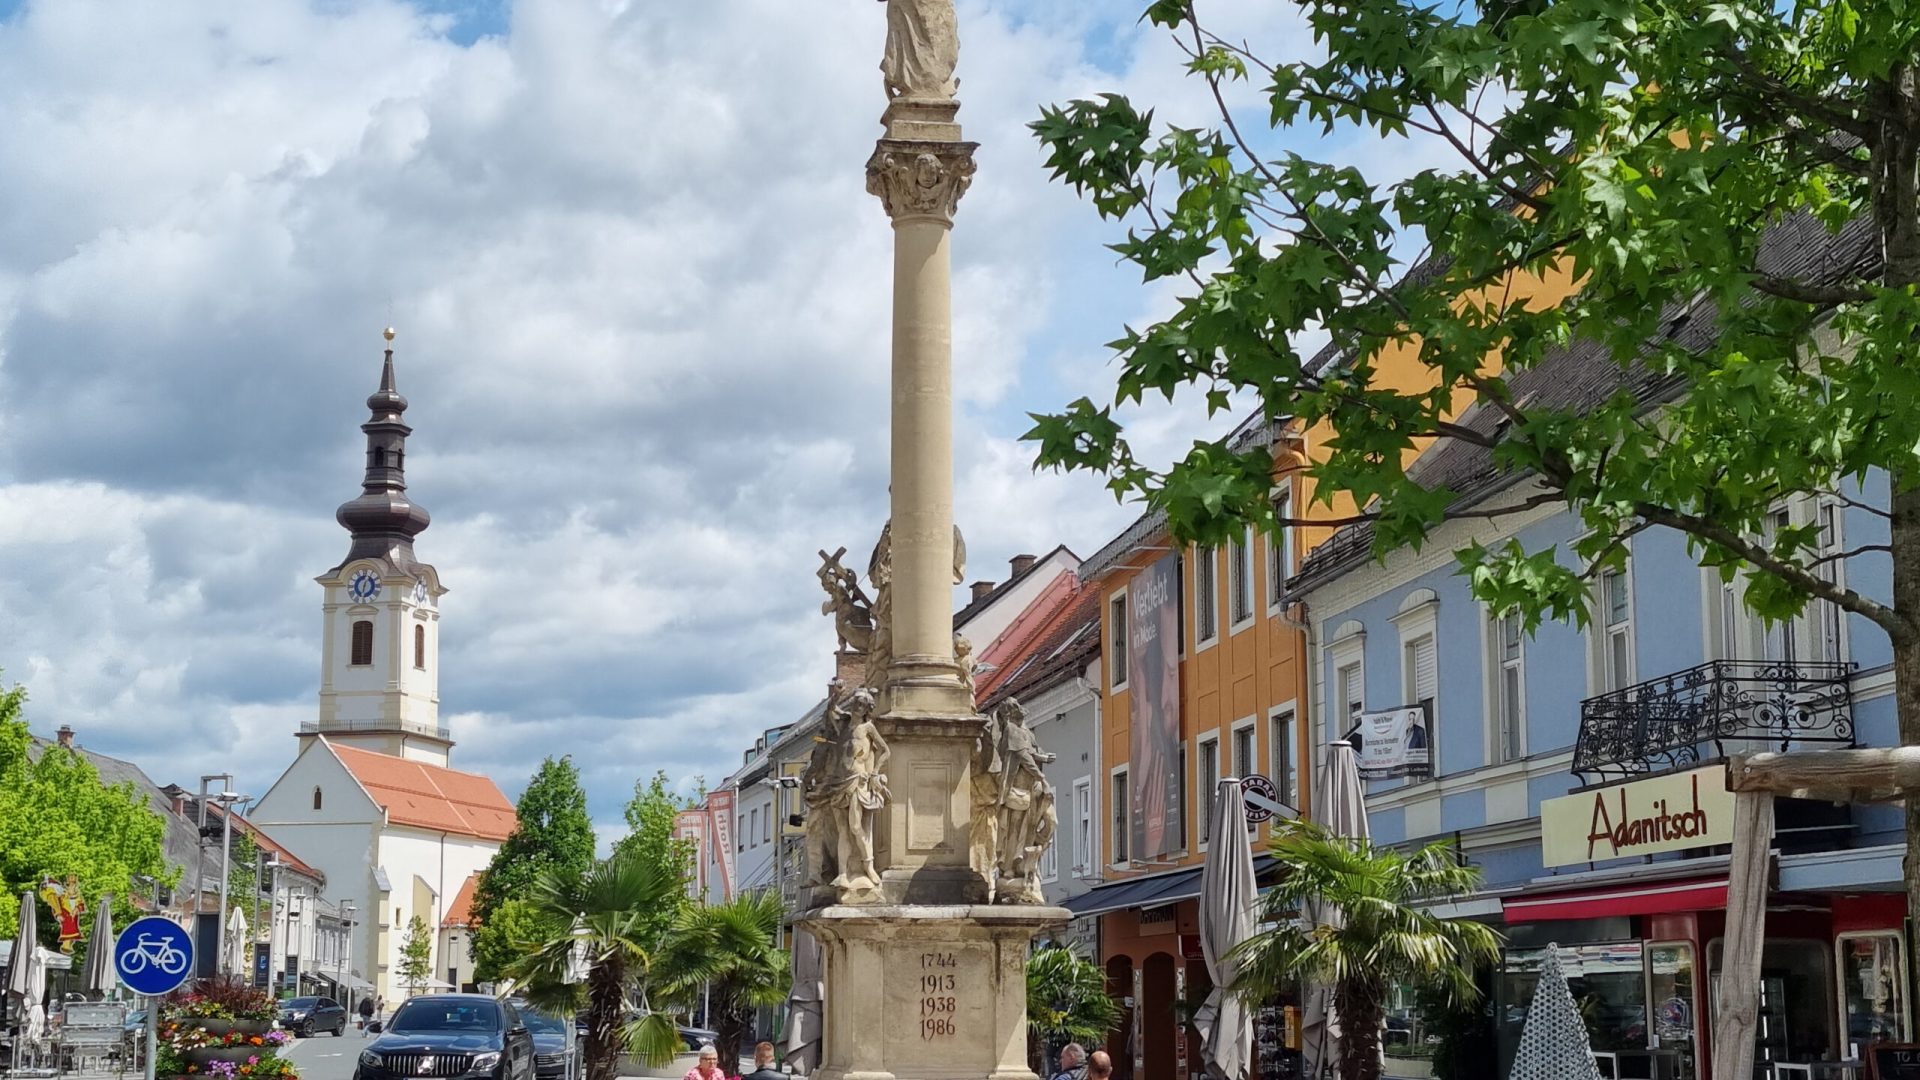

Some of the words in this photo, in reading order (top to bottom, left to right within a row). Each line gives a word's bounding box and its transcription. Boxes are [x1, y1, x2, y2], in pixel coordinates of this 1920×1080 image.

[1133, 572, 1168, 619] Verliebt
[1242, 780, 1275, 797] TABAK
[1587, 774, 1707, 859] Adanitsch
[920, 953, 958, 971] 1744
[920, 974, 956, 994] 1913
[920, 996, 956, 1017] 1938
[920, 1015, 956, 1041] 1986
